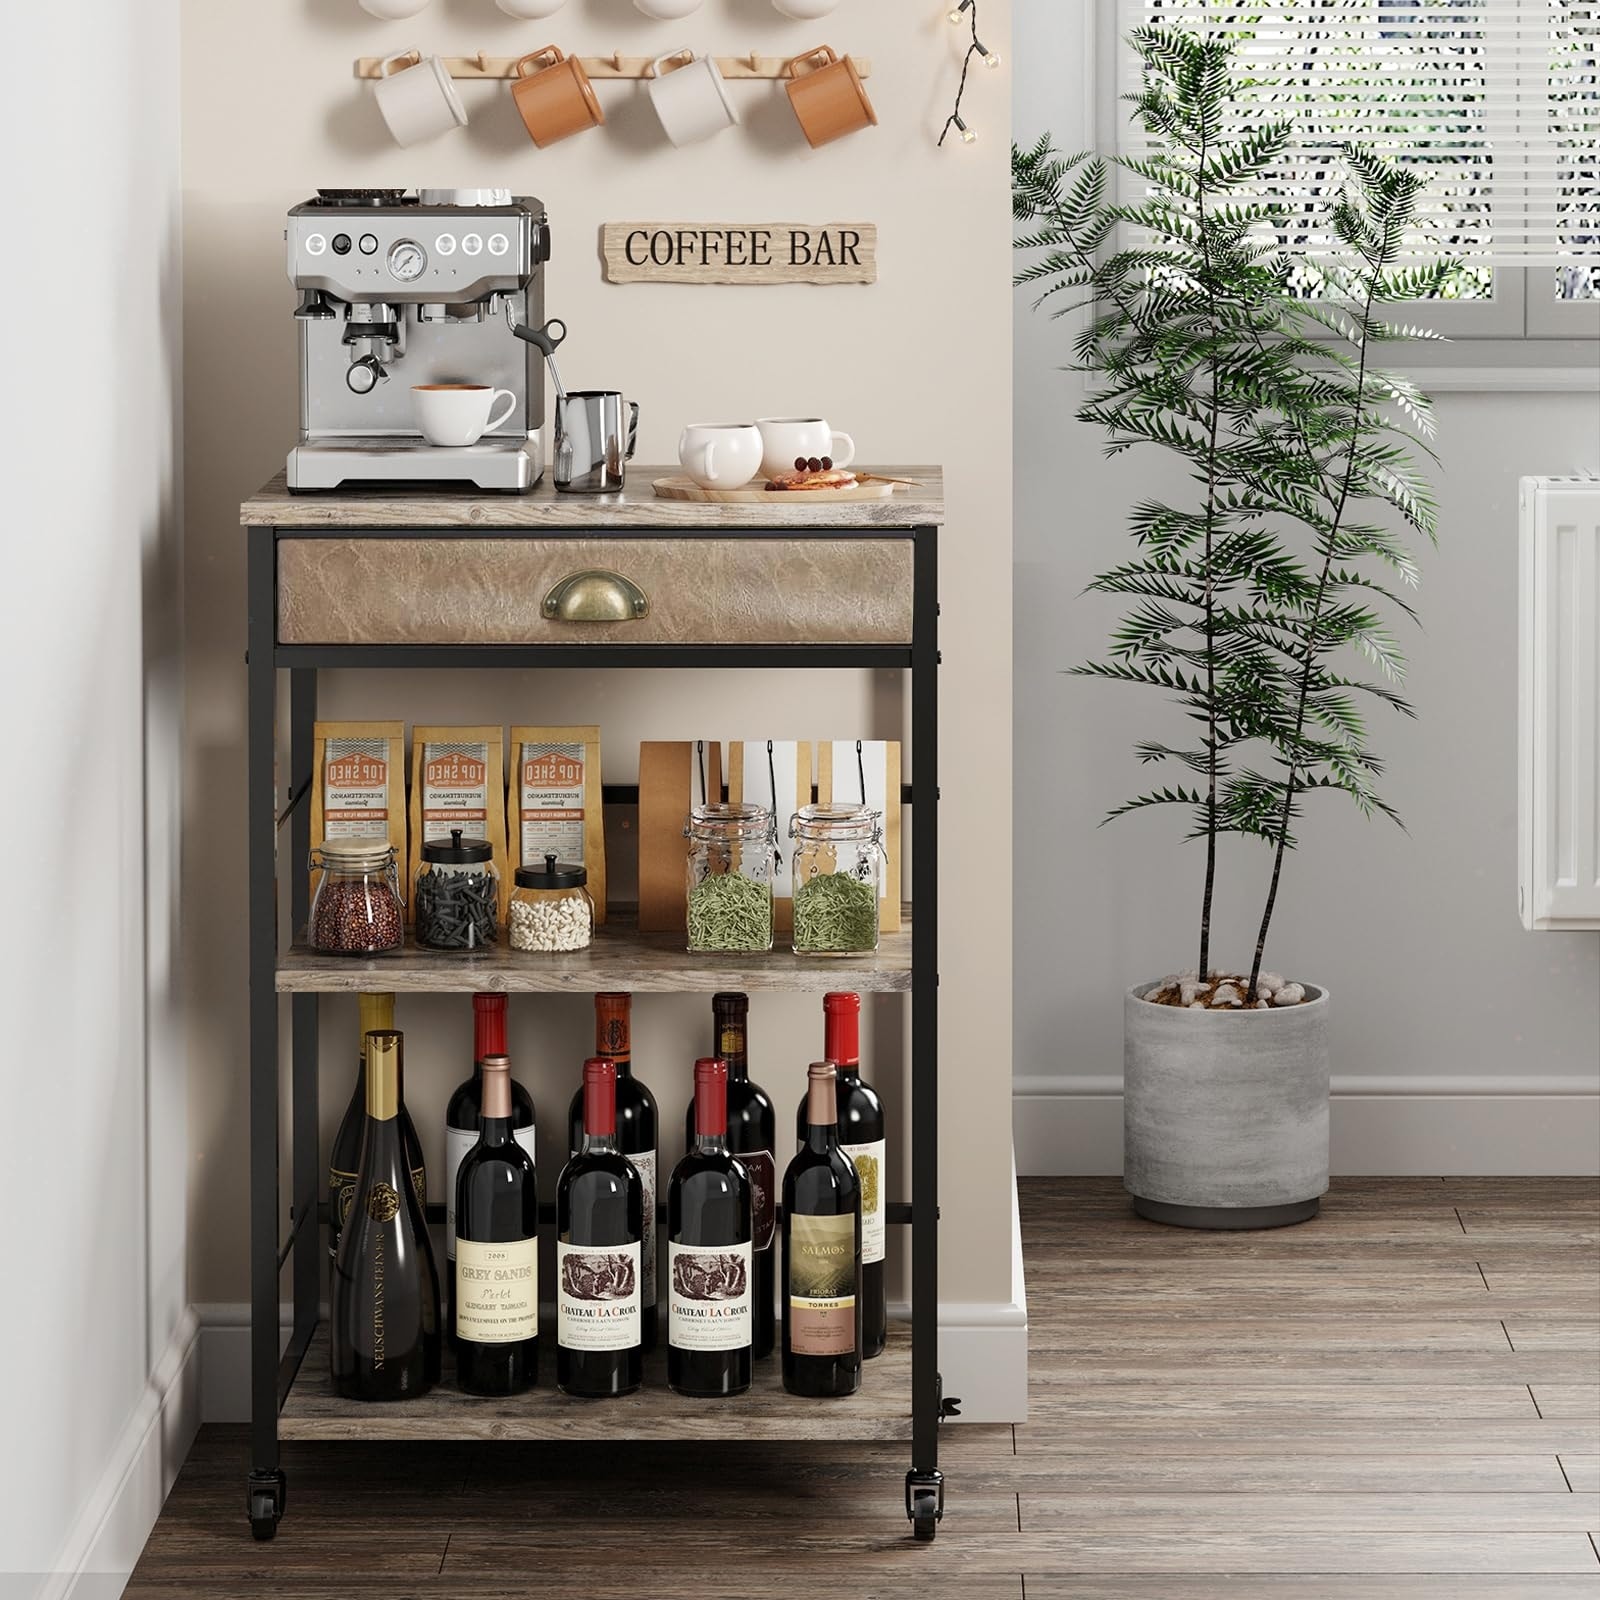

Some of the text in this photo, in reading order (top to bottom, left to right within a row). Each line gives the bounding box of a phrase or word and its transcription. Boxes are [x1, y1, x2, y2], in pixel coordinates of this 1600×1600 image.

[625, 230, 862, 266] COFFEE BAR
[801, 1245, 845, 1255] SALMOS
[462, 1265, 532, 1281] GREY SANDS
[374, 1231, 385, 1371] NEUSCHWANSTEINER
[597, 1307, 611, 1317] LA
[612, 1304, 638, 1317] CROIX
[709, 1307, 722, 1317] LA
[723, 1304, 749, 1317] CROIX
